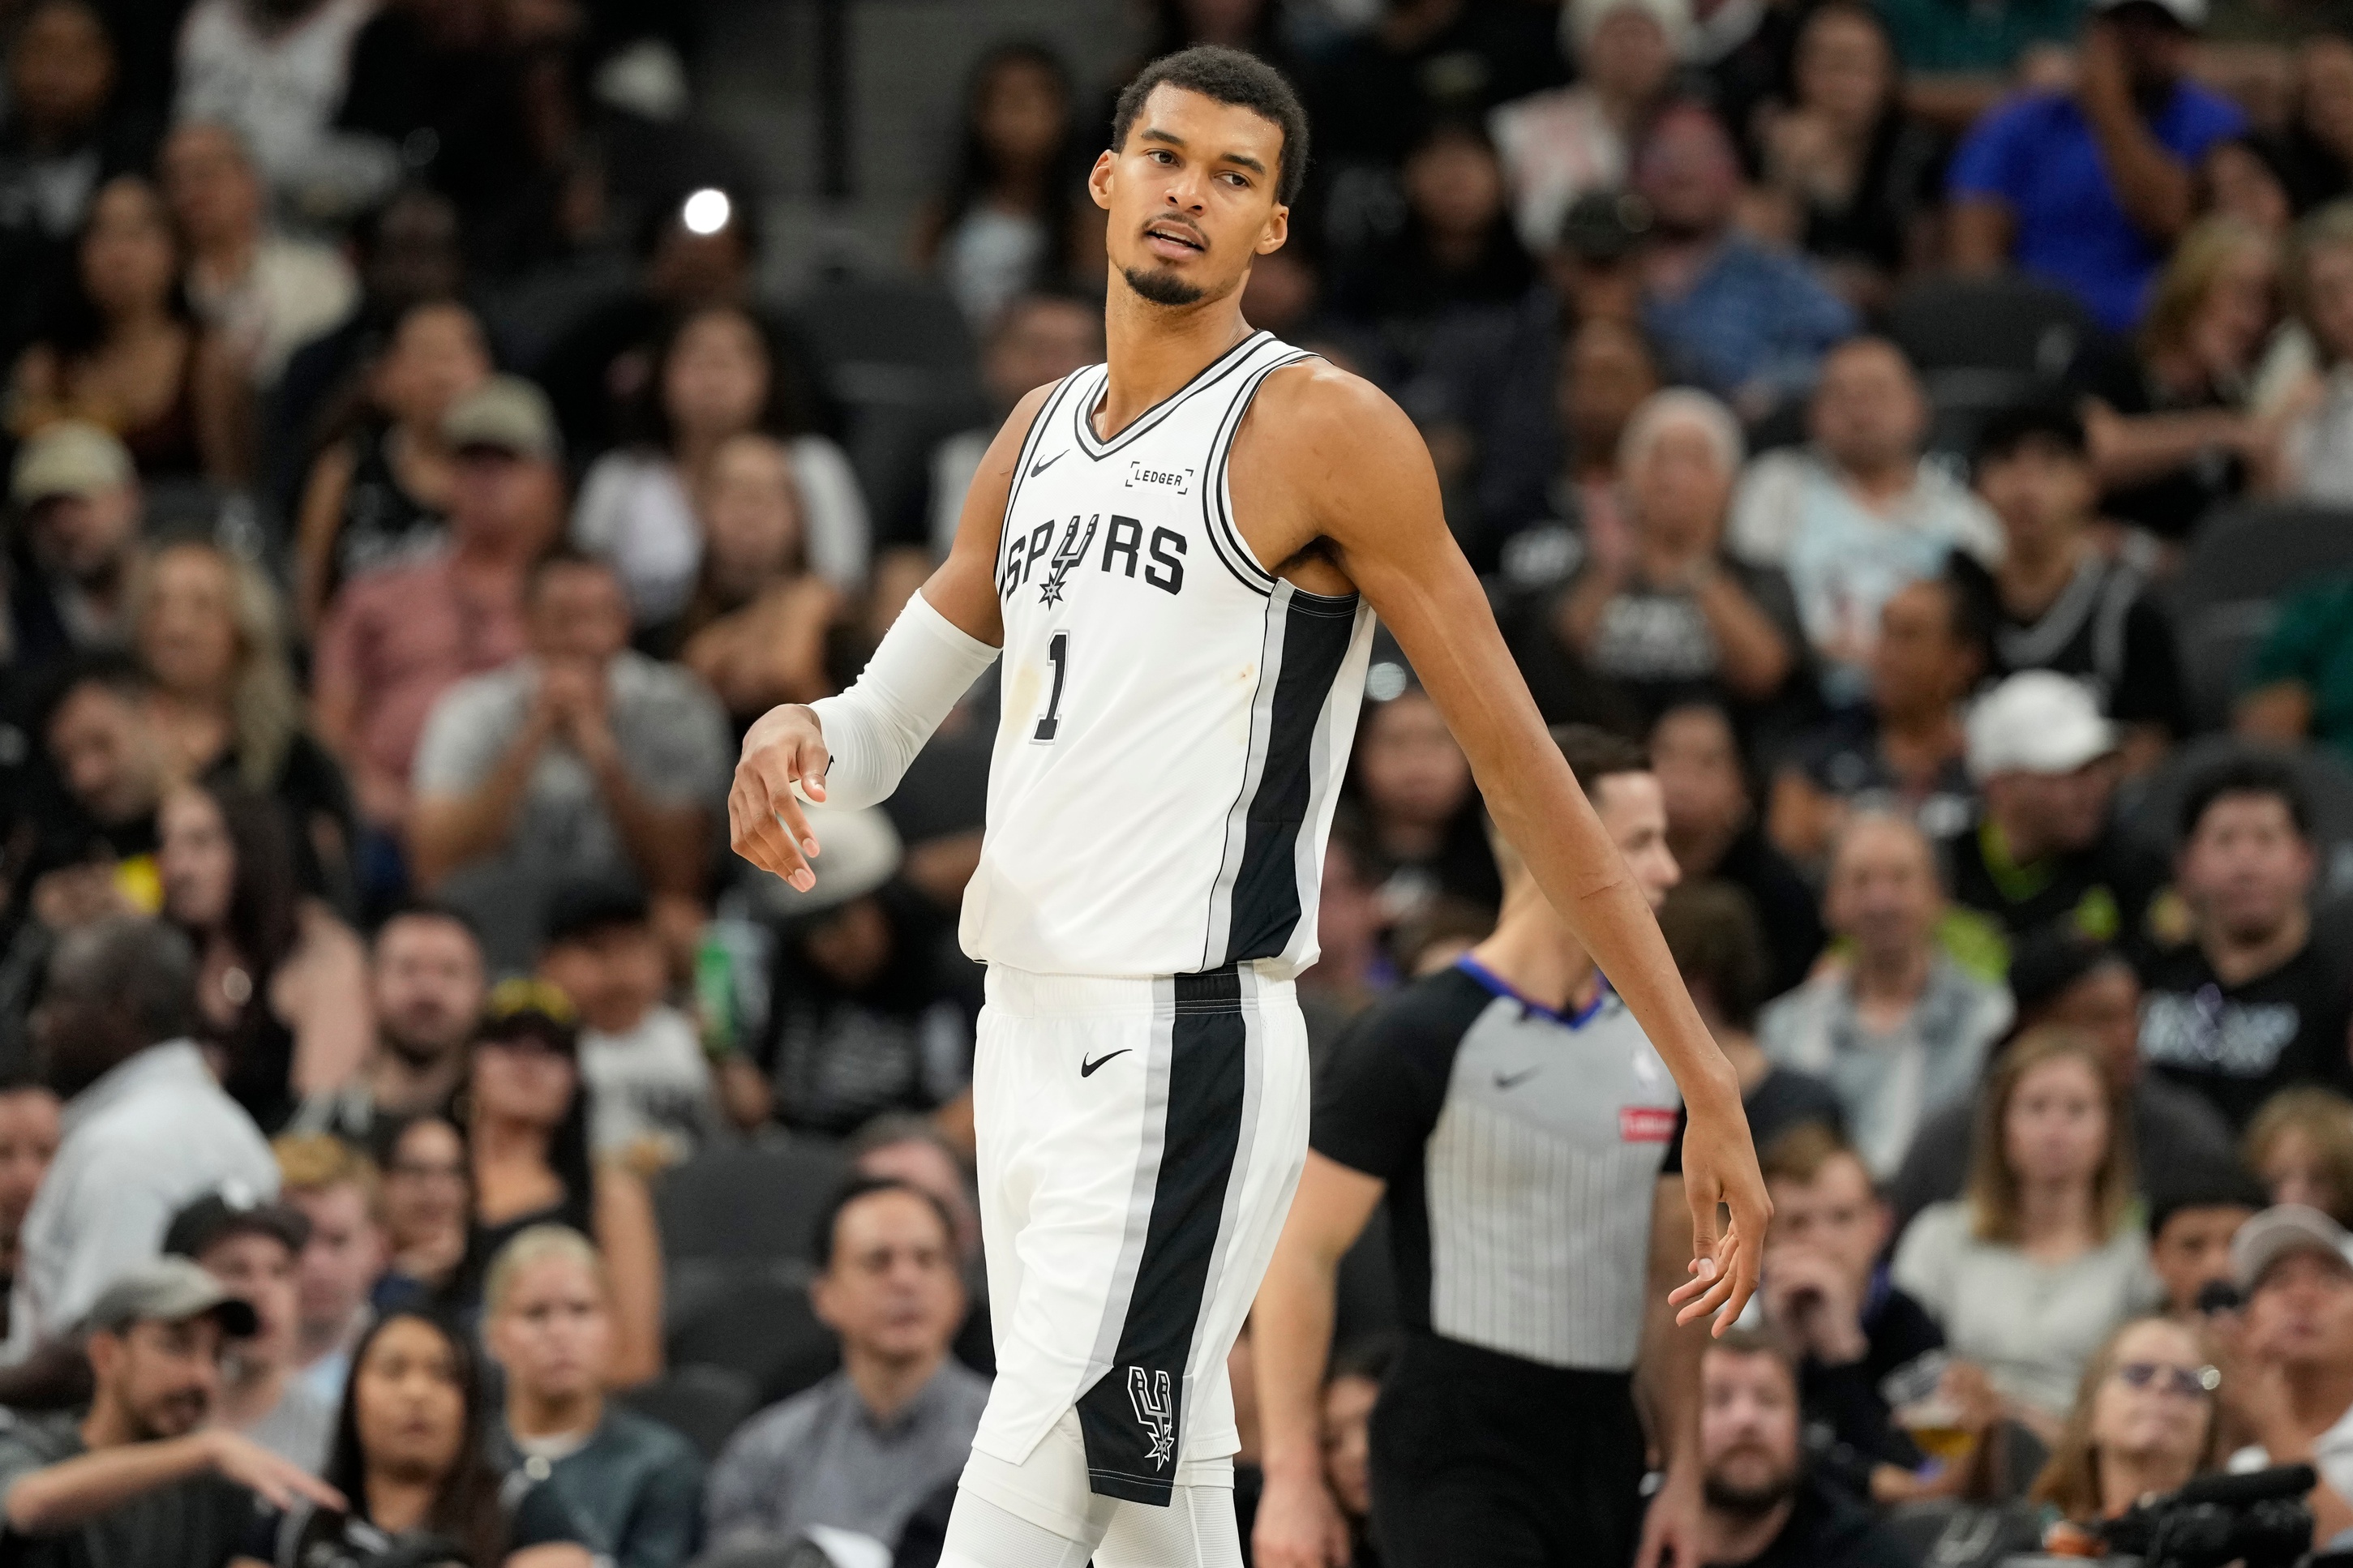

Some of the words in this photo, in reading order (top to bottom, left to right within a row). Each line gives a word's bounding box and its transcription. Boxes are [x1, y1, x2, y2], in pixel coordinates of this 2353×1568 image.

[1134, 469, 1182, 486] LEDGER
[1005, 513, 1188, 611] SPURS
[1030, 630, 1070, 744] 1
